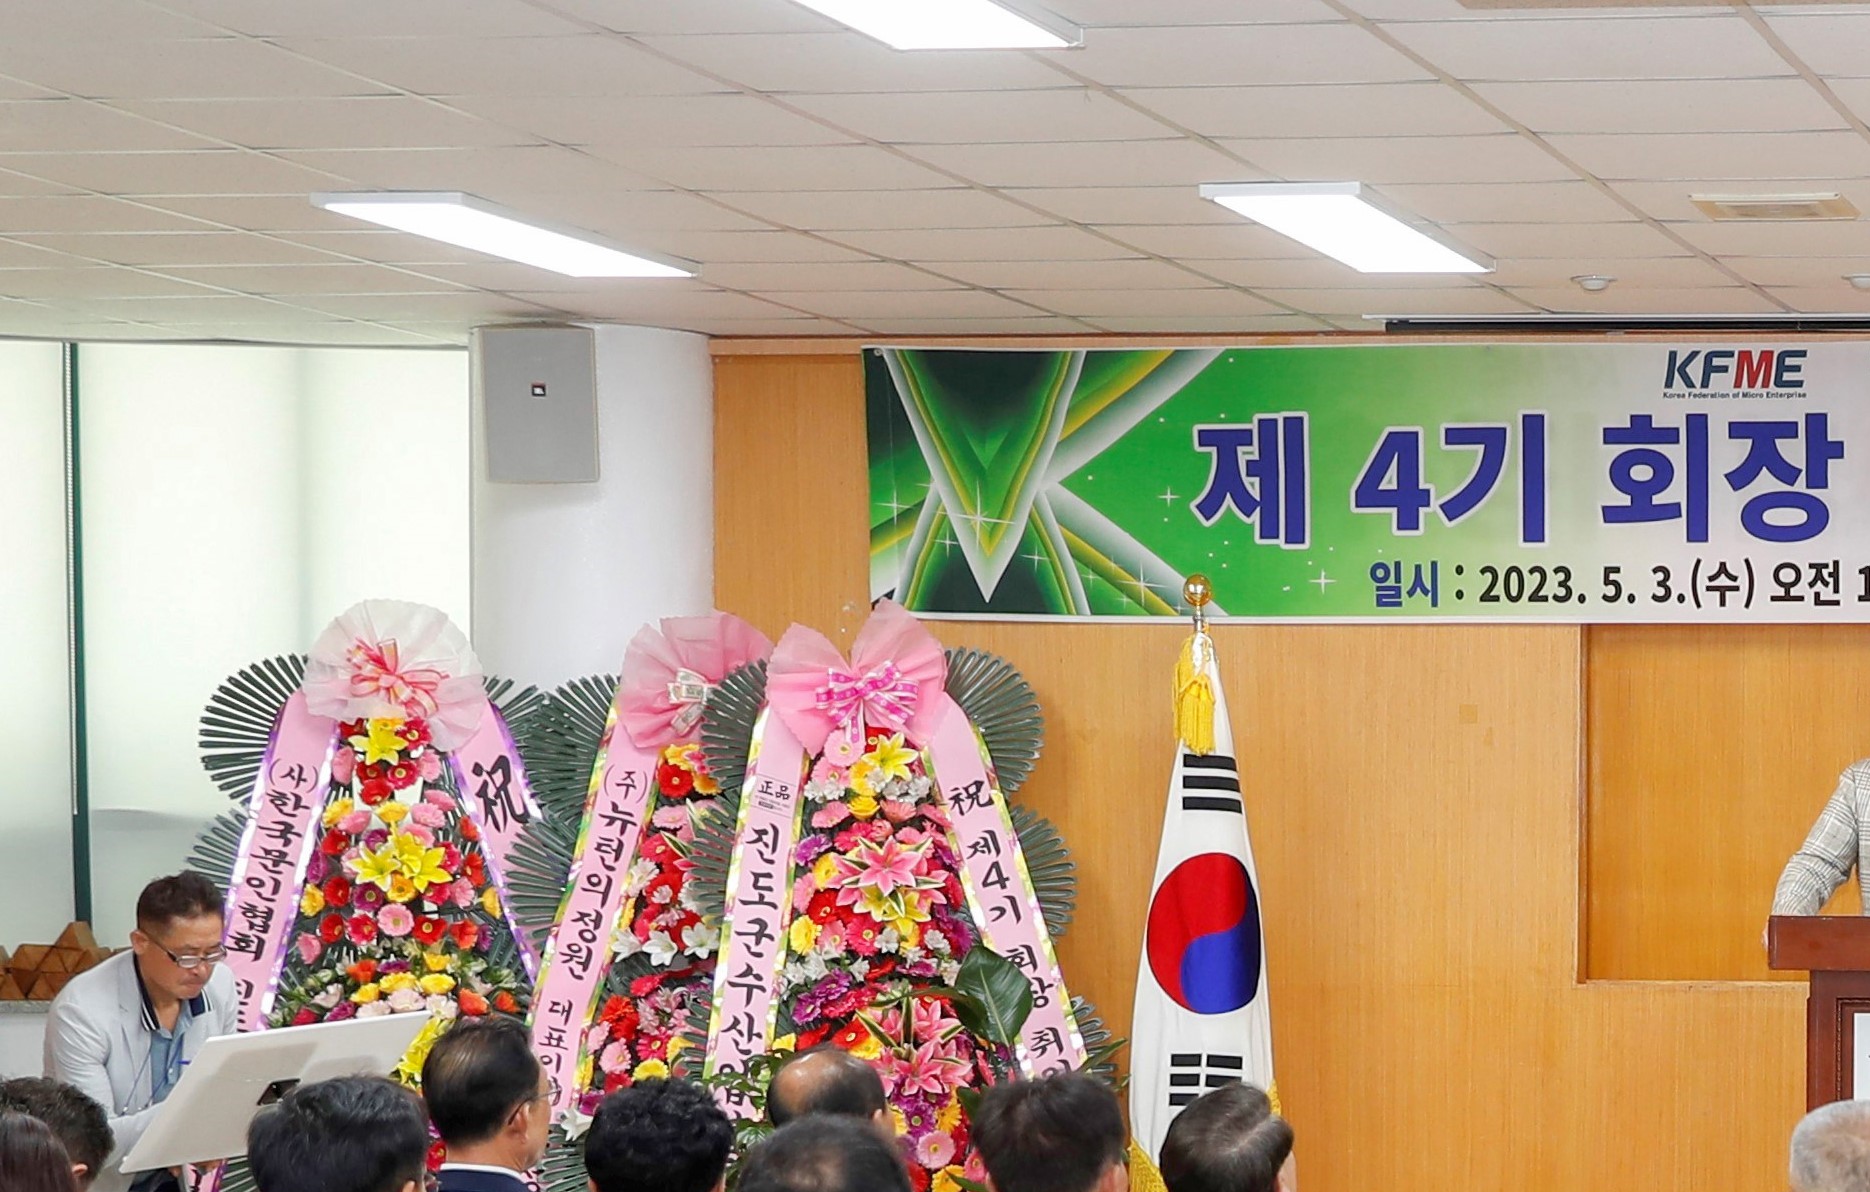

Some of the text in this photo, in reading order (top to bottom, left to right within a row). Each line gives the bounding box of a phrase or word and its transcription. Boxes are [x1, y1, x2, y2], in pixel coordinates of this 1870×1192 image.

[1664, 349, 1808, 389] KFME
[1663, 391, 1807, 400] Korea Federation of Micro Enterprise
[1197, 413, 1304, 544] 제
[1353, 413, 1545, 543] 4기
[1601, 412, 1844, 543] 회장
[1370, 561, 1439, 607] 일시
[1479, 565, 1587, 603] 2023.
[1602, 565, 1641, 603] 5.
[1652, 559, 1755, 610] 3.(수)
[1771, 561, 1841, 605] 오전
[472, 755, 534, 832] 祝
[949, 780, 993, 816] 祝
